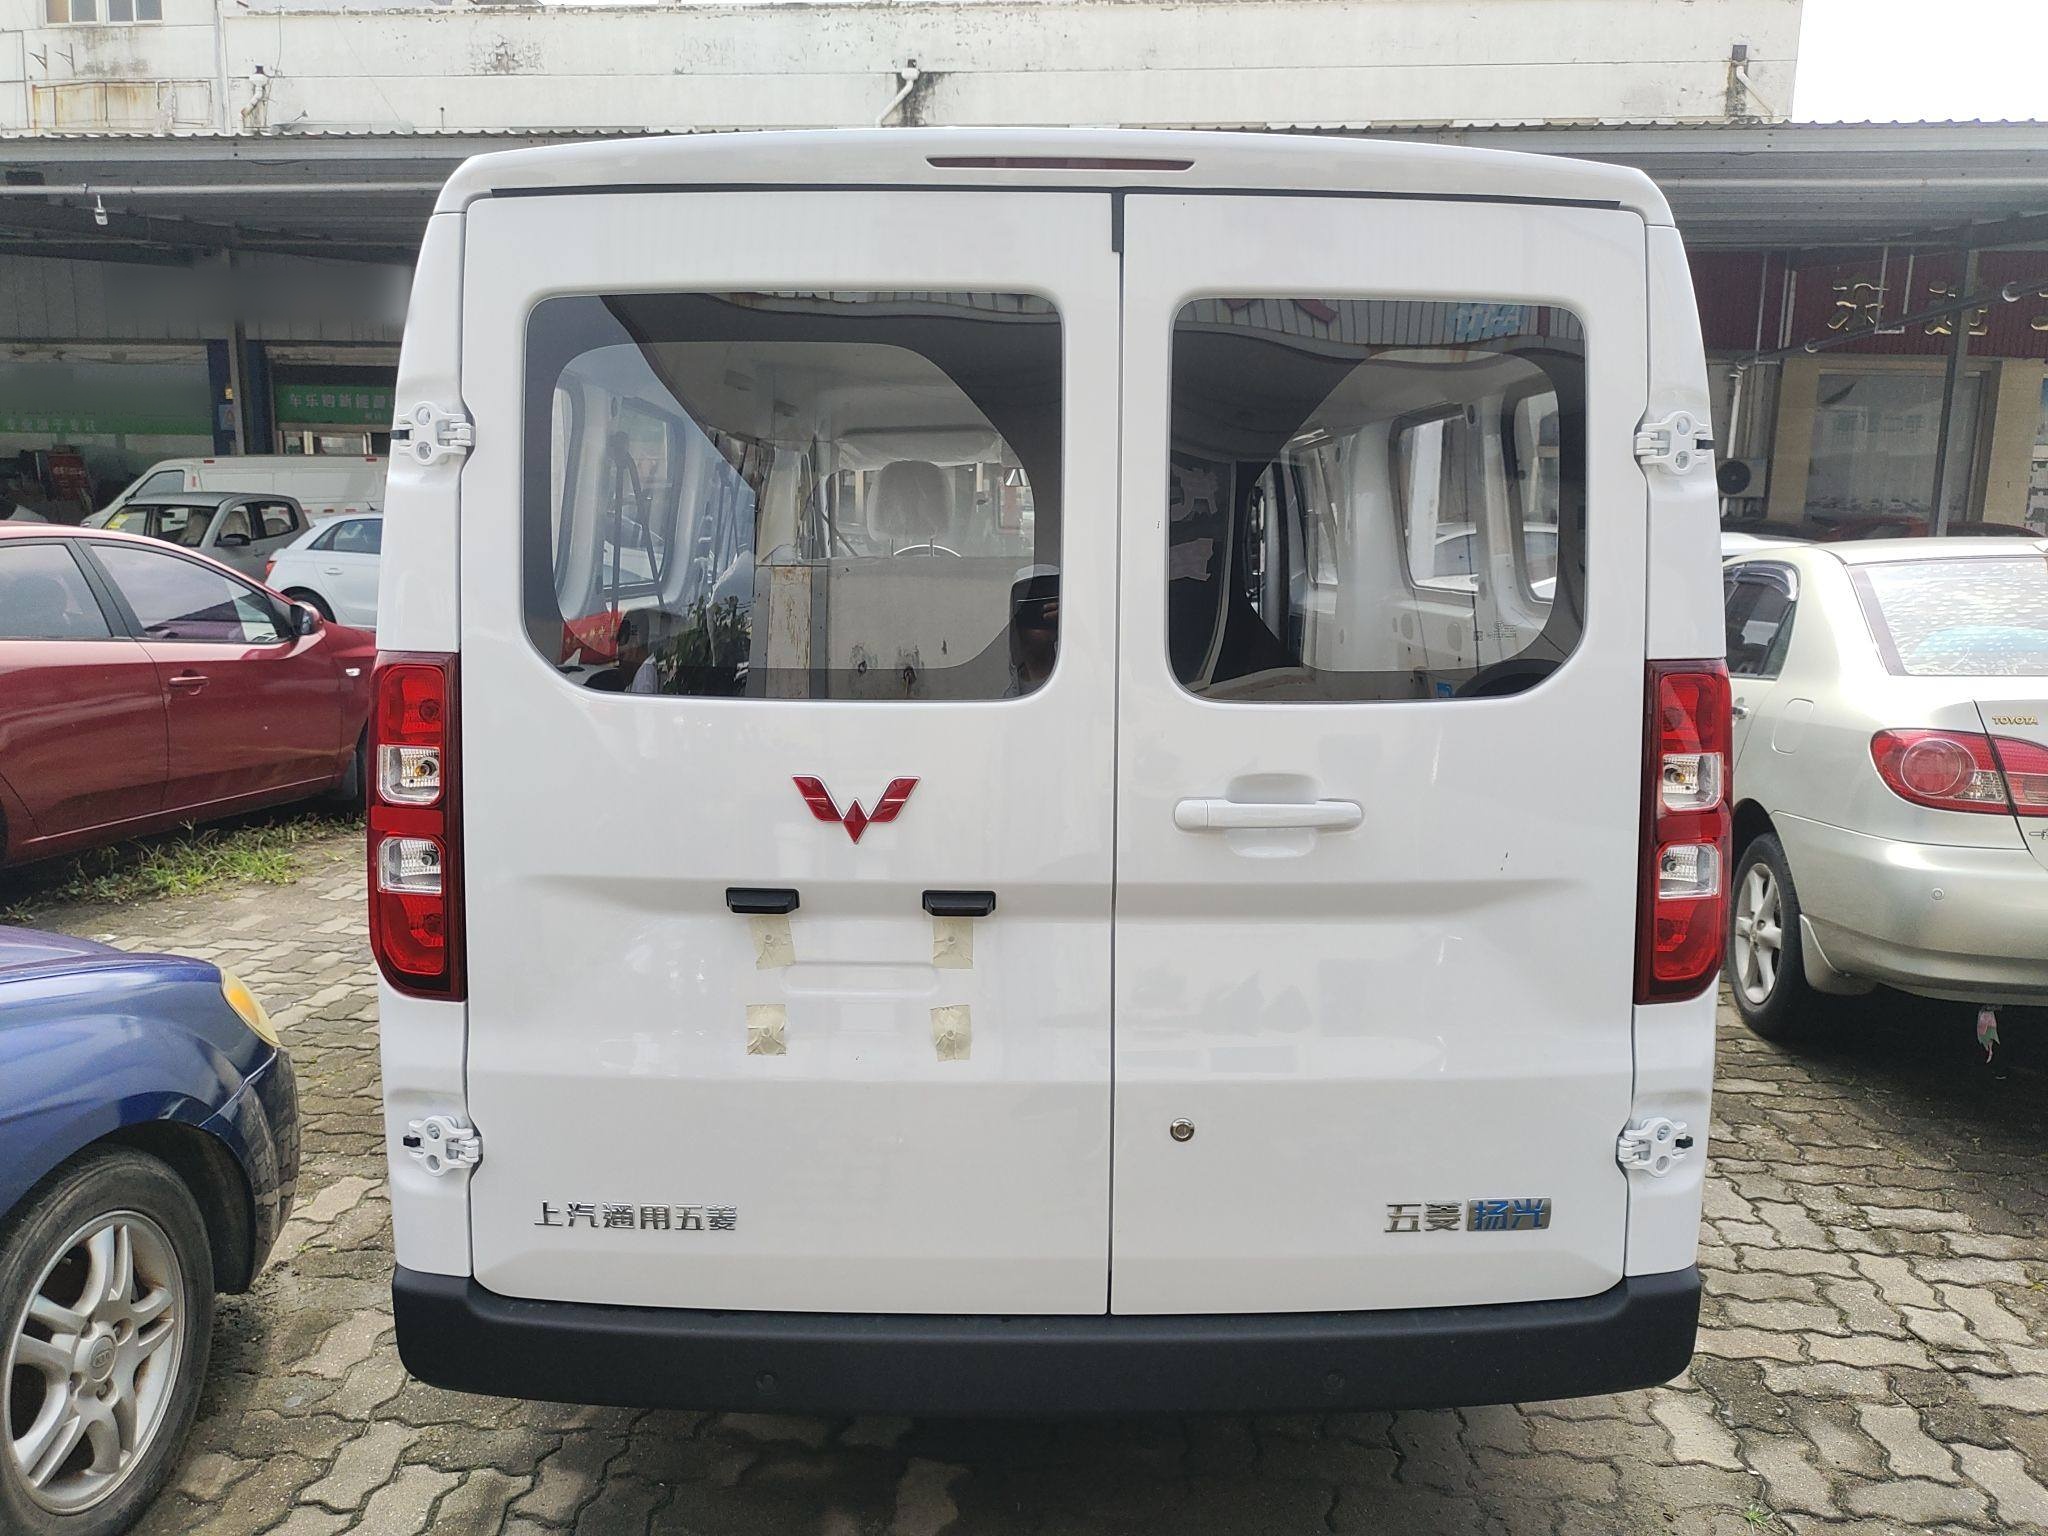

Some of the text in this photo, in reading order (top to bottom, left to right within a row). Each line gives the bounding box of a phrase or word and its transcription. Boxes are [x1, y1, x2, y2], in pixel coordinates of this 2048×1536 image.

[1992, 715, 2039, 726] TOYOTA
[533, 1199, 738, 1232] 上汽通用五菱
